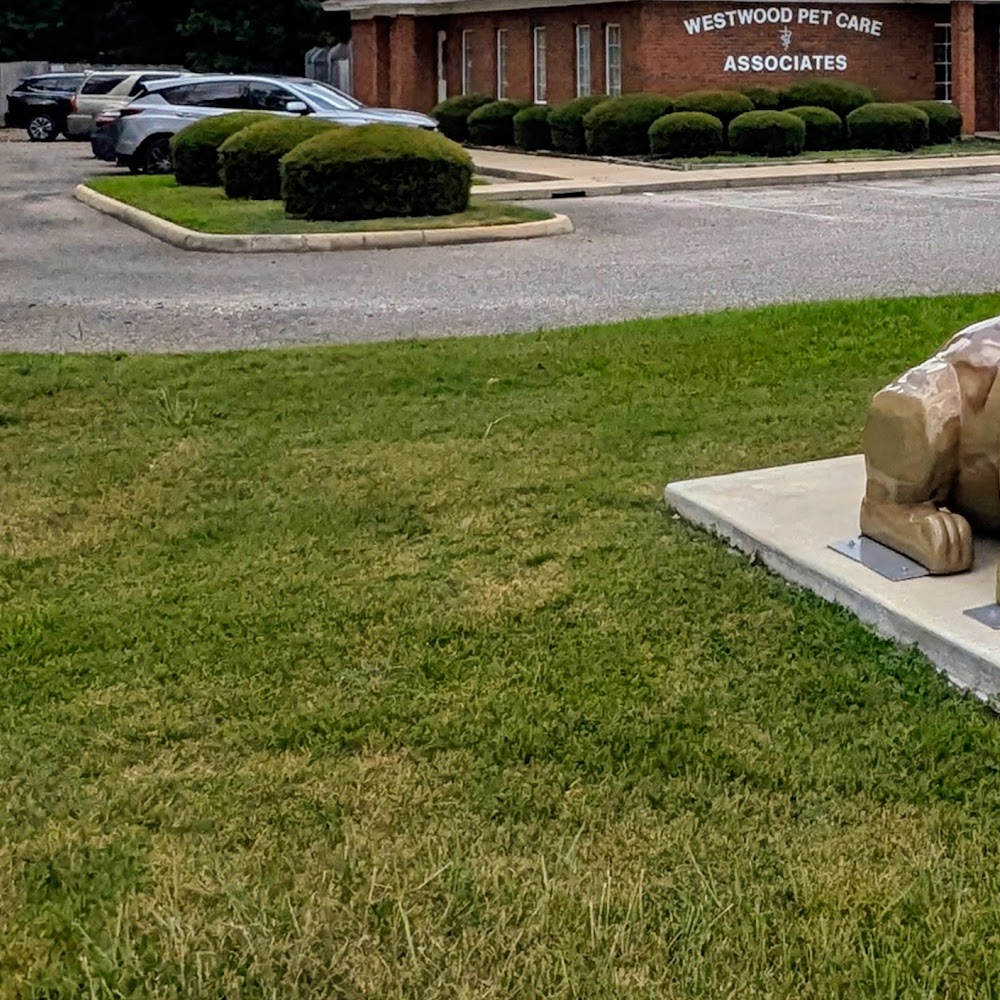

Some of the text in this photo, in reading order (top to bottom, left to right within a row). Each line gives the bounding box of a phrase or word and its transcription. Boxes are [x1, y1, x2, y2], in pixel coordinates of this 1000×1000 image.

[684, 7, 883, 37] WESTWOOD PET CARE
[723, 55, 848, 72] ASSOCIATES
